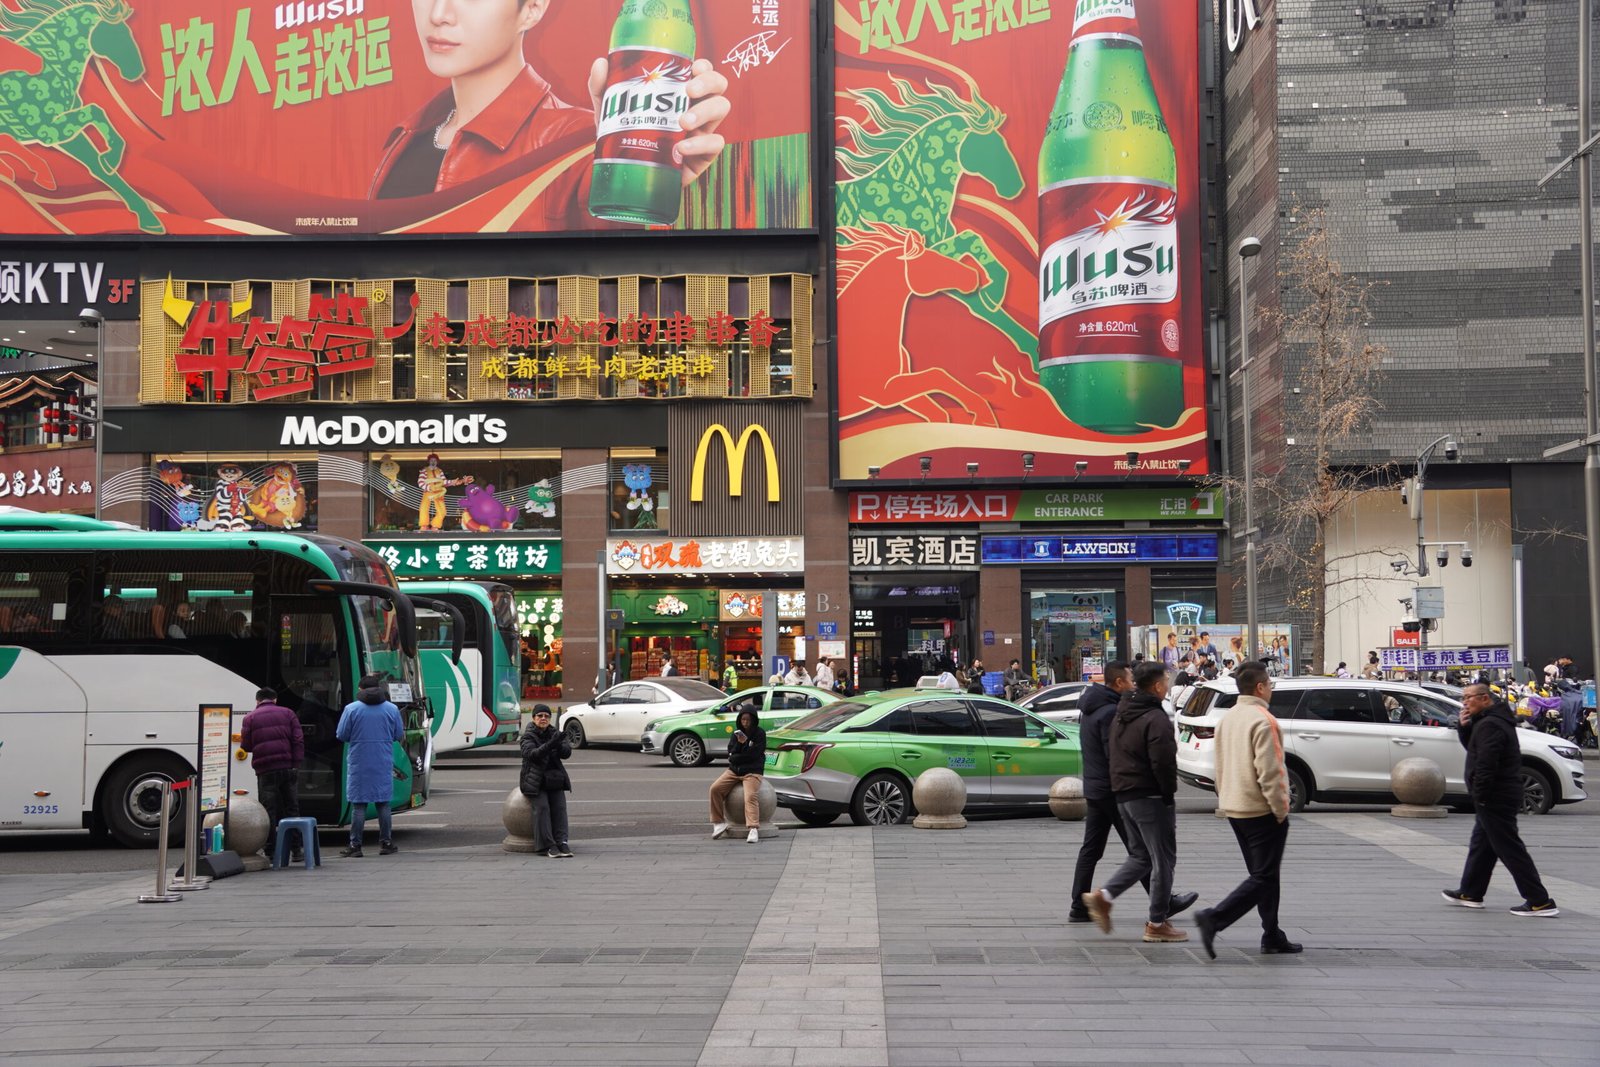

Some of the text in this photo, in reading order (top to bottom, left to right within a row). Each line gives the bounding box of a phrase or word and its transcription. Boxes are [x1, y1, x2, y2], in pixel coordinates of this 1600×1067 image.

[295, 217, 358, 226] 未成年人禁止饮酒
[107, 279, 135, 303] 3F
[1071, 282, 1147, 304] 乌苏啤酒
[420, 309, 782, 349] 来成都必吃的串串香
[174, 293, 376, 400] 牛签签
[480, 353, 715, 380] 成都鲜牛肉老串串
[280, 415, 507, 446] McDonald's
[885, 495, 1007, 519] 停车场入口
[1045, 493, 1104, 503] CAR PARK
[1161, 498, 1187, 510] 汇泊
[1034, 506, 1104, 517] ENTERANCE
[852, 536, 976, 567] 凯宾酒店
[1063, 542, 1129, 554] LAWSON
[817, 593, 829, 613] B
[1171, 605, 1198, 613] LAWSON
[1422, 649, 1509, 665] 香煎毛豆腐
[24, 805, 58, 814] 32925
